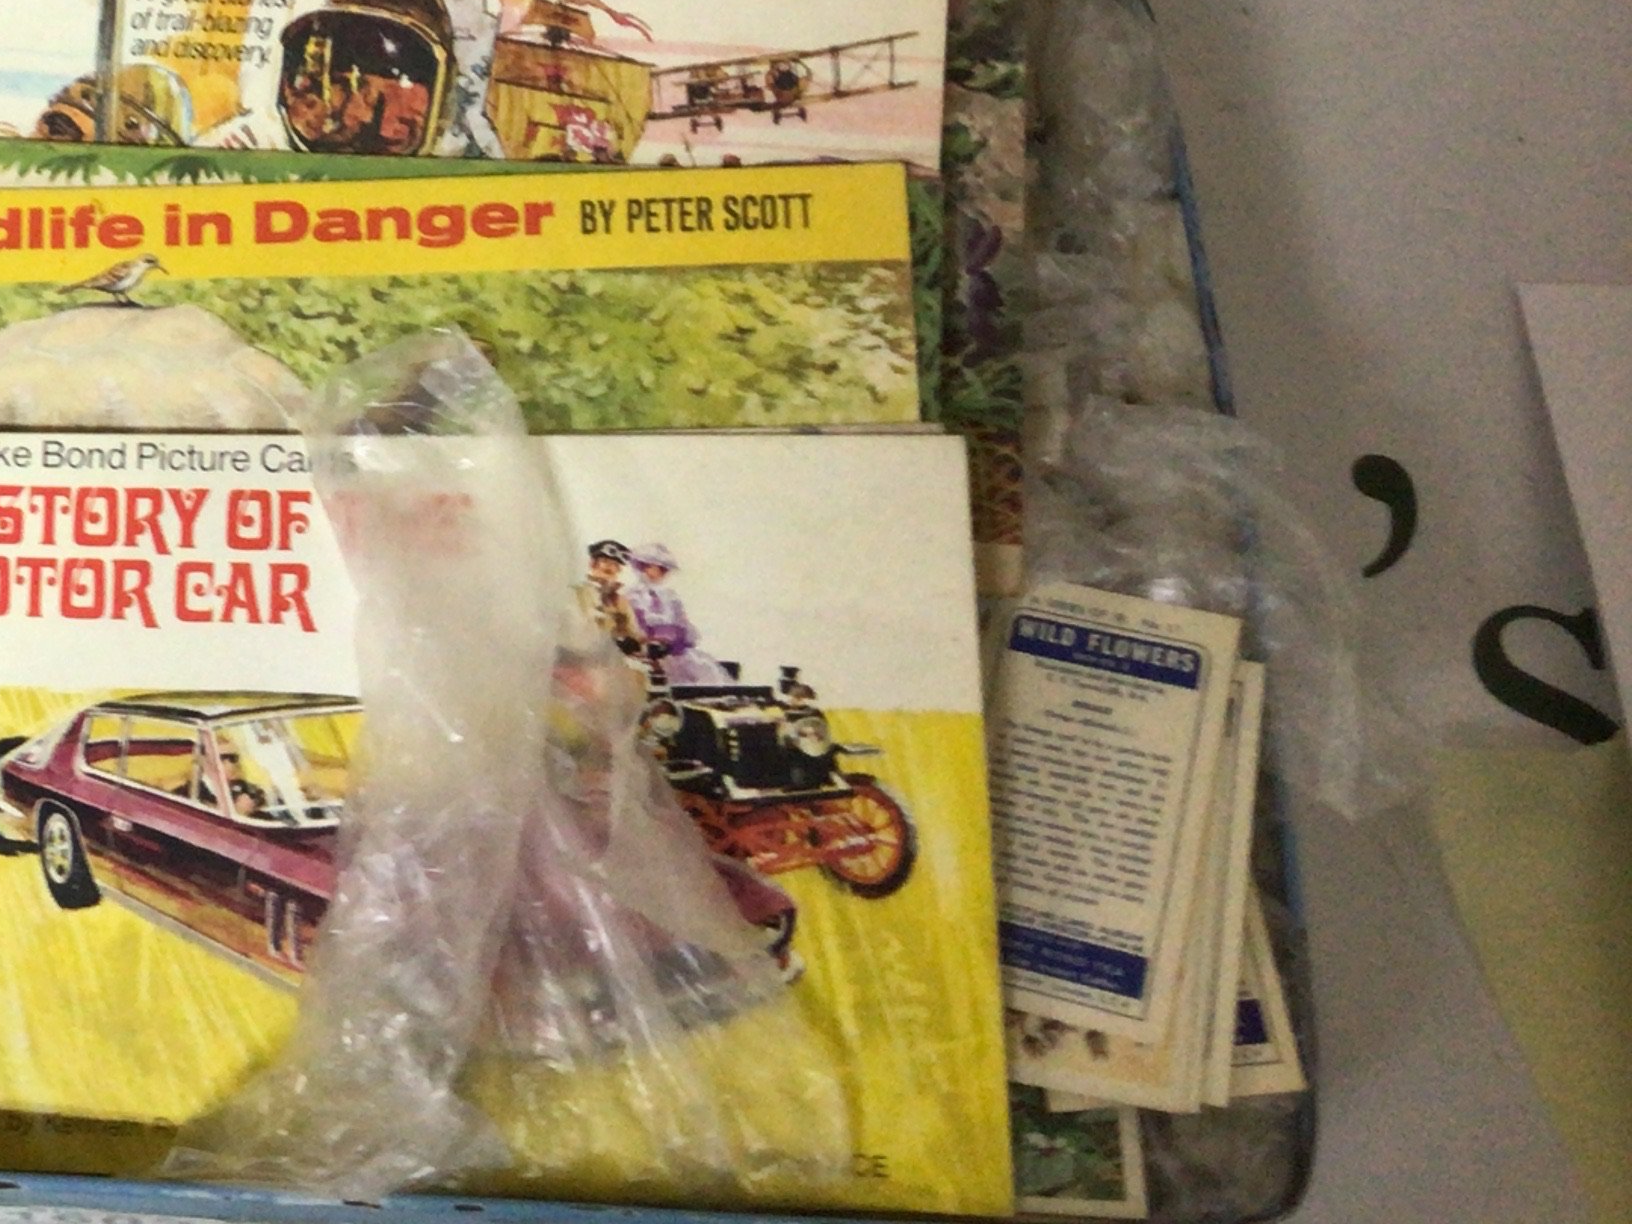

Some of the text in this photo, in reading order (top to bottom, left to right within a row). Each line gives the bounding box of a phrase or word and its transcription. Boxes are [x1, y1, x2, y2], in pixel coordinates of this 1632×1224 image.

[129, 6, 153, 31] of
[129, 37, 170, 58] and
[164, 203, 233, 247] in
[253, 198, 557, 248] Danger
[579, 198, 615, 235] BY
[625, 194, 715, 234] PETER
[722, 192, 814, 232] SCOTT
[42, 439, 127, 471] Bond
[136, 442, 252, 473] Picture
[224, 486, 314, 552] OF
[174, 560, 319, 634] CAR
[1017, 617, 1078, 648] WILD
[1085, 632, 1198, 674] FLOWERS
